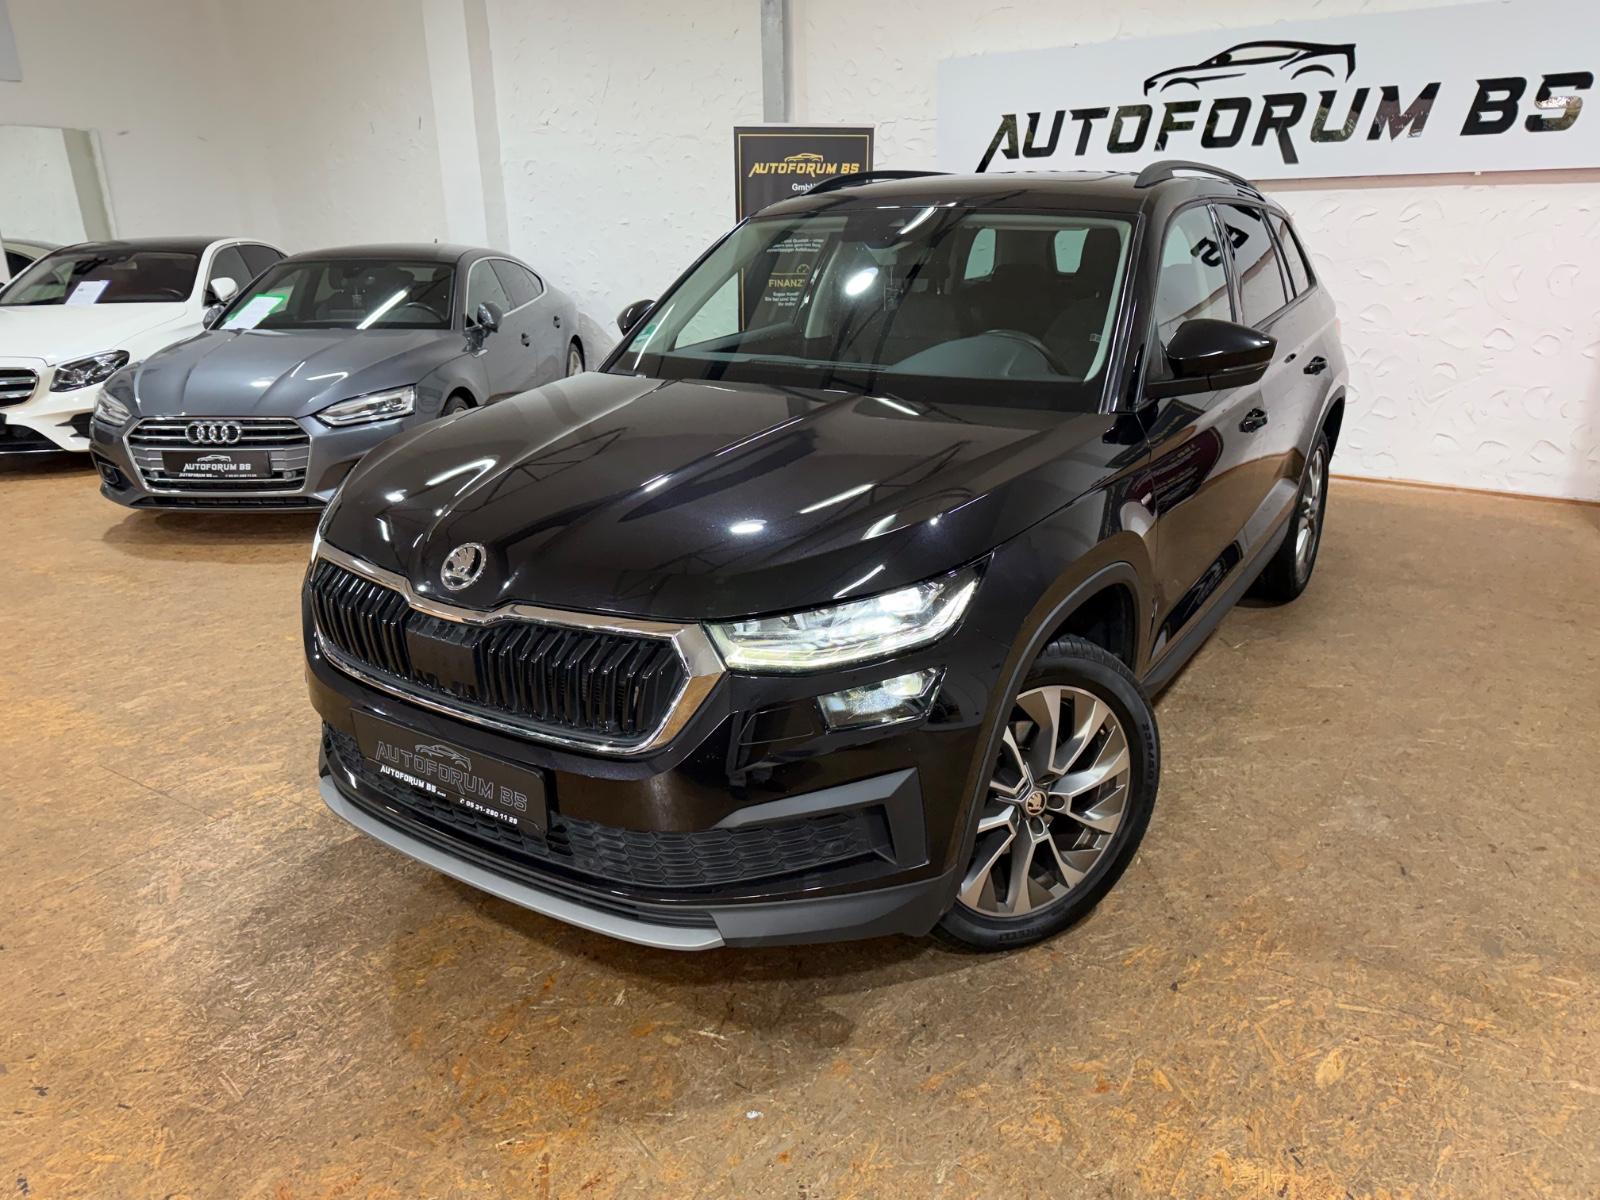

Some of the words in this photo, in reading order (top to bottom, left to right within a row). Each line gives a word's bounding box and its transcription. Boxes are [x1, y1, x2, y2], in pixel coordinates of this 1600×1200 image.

[975, 82, 1442, 173] AUTOFORUM
[1460, 72, 1594, 136] BS
[748, 163, 837, 177] AUTOFORUM
[840, 163, 860, 174] BS
[183, 463, 237, 472] AUTOFORUM
[376, 741, 494, 800] AUTOFORUM
[500, 786, 528, 812] BS
[380, 765, 425, 788] AUTOFORUM
[426, 782, 437, 793] BS
